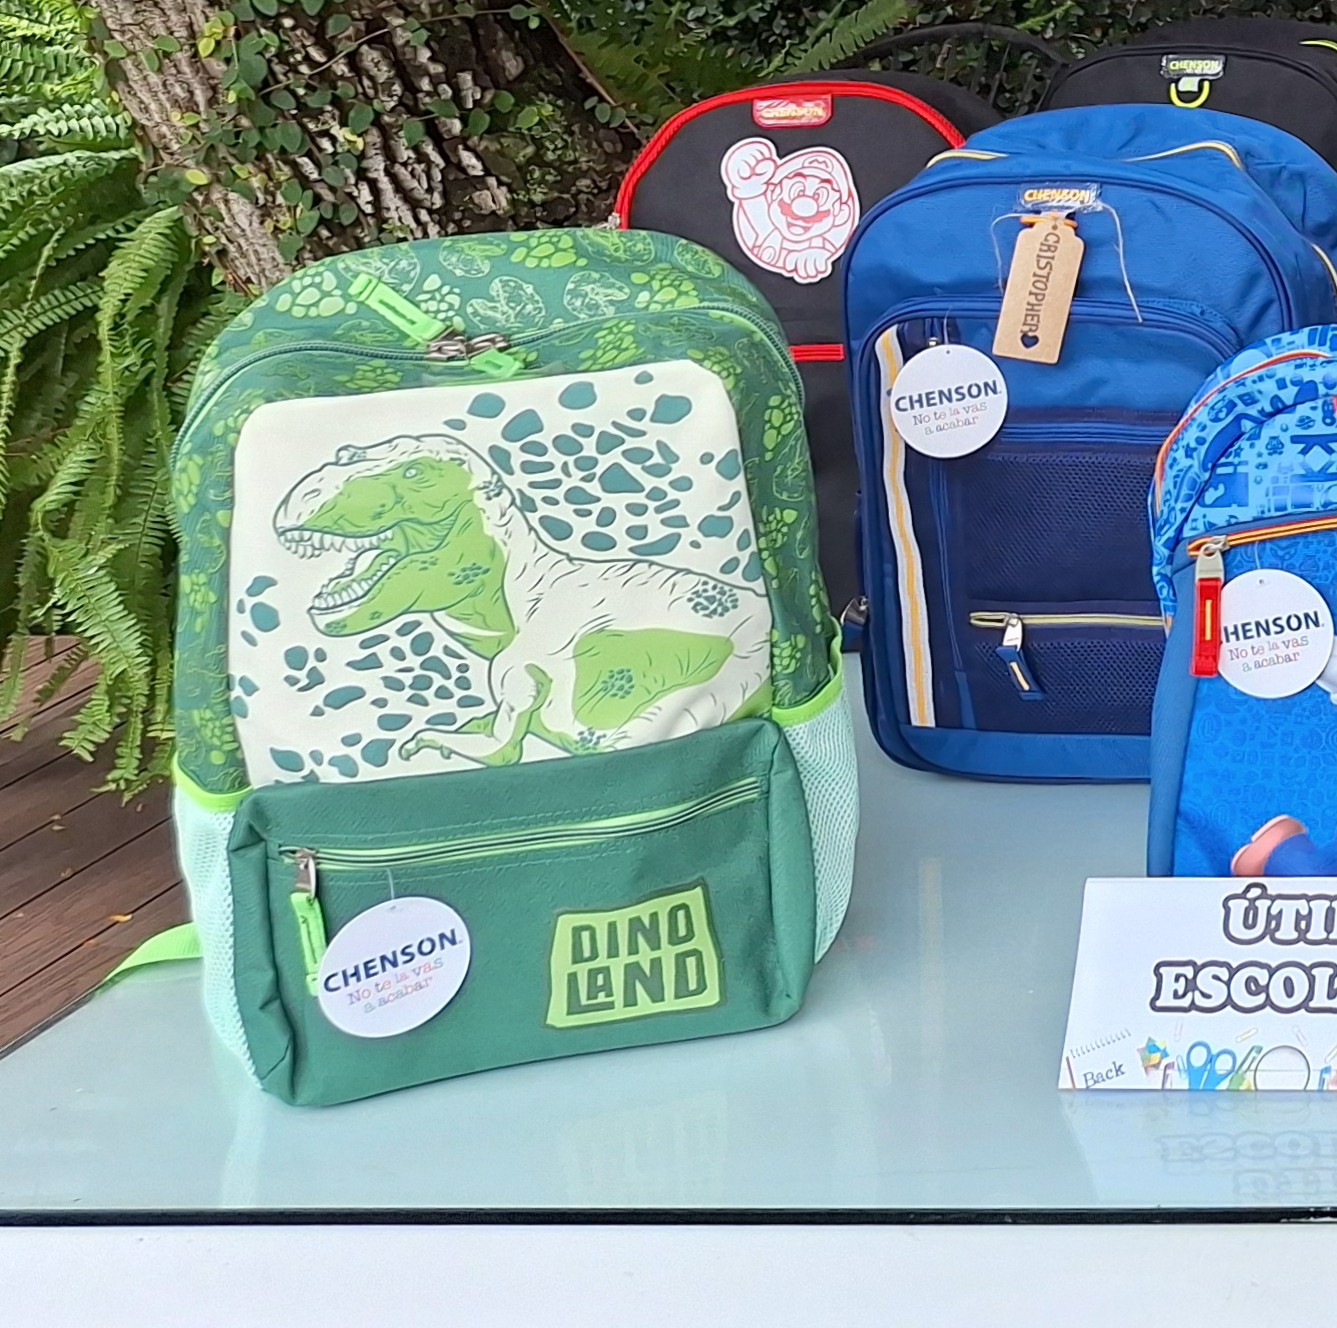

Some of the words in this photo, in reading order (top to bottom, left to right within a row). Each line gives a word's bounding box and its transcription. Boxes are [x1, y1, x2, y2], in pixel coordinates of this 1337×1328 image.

[1023, 188, 1092, 203] CHENSON
[1020, 232, 1061, 336] CRISTOPHER
[894, 379, 999, 413] CHENSON
[912, 413, 931, 426] No
[933, 411, 947, 421] te
[949, 407, 960, 417] la
[962, 401, 988, 415] vas
[924, 426, 934, 436] a
[935, 415, 979, 433] acabar
[1220, 609, 1322, 645] HENSON
[1228, 647, 1248, 661] No
[1250, 643, 1265, 657] te
[1267, 640, 1280, 651] la
[1282, 635, 1309, 650] vas
[1242, 661, 1252, 673] a
[1253, 651, 1301, 670] acabar
[571, 902, 696, 966] DINO
[323, 927, 458, 994] CHENSON
[348, 988, 372, 1006] No
[374, 978, 392, 993] te
[394, 970, 410, 984] la
[411, 957, 444, 977] vas
[363, 1001, 377, 1014] a
[377, 976, 434, 1007] acabar
[565, 947, 708, 1016] LAND
[1081, 1060, 1126, 1089] Back
